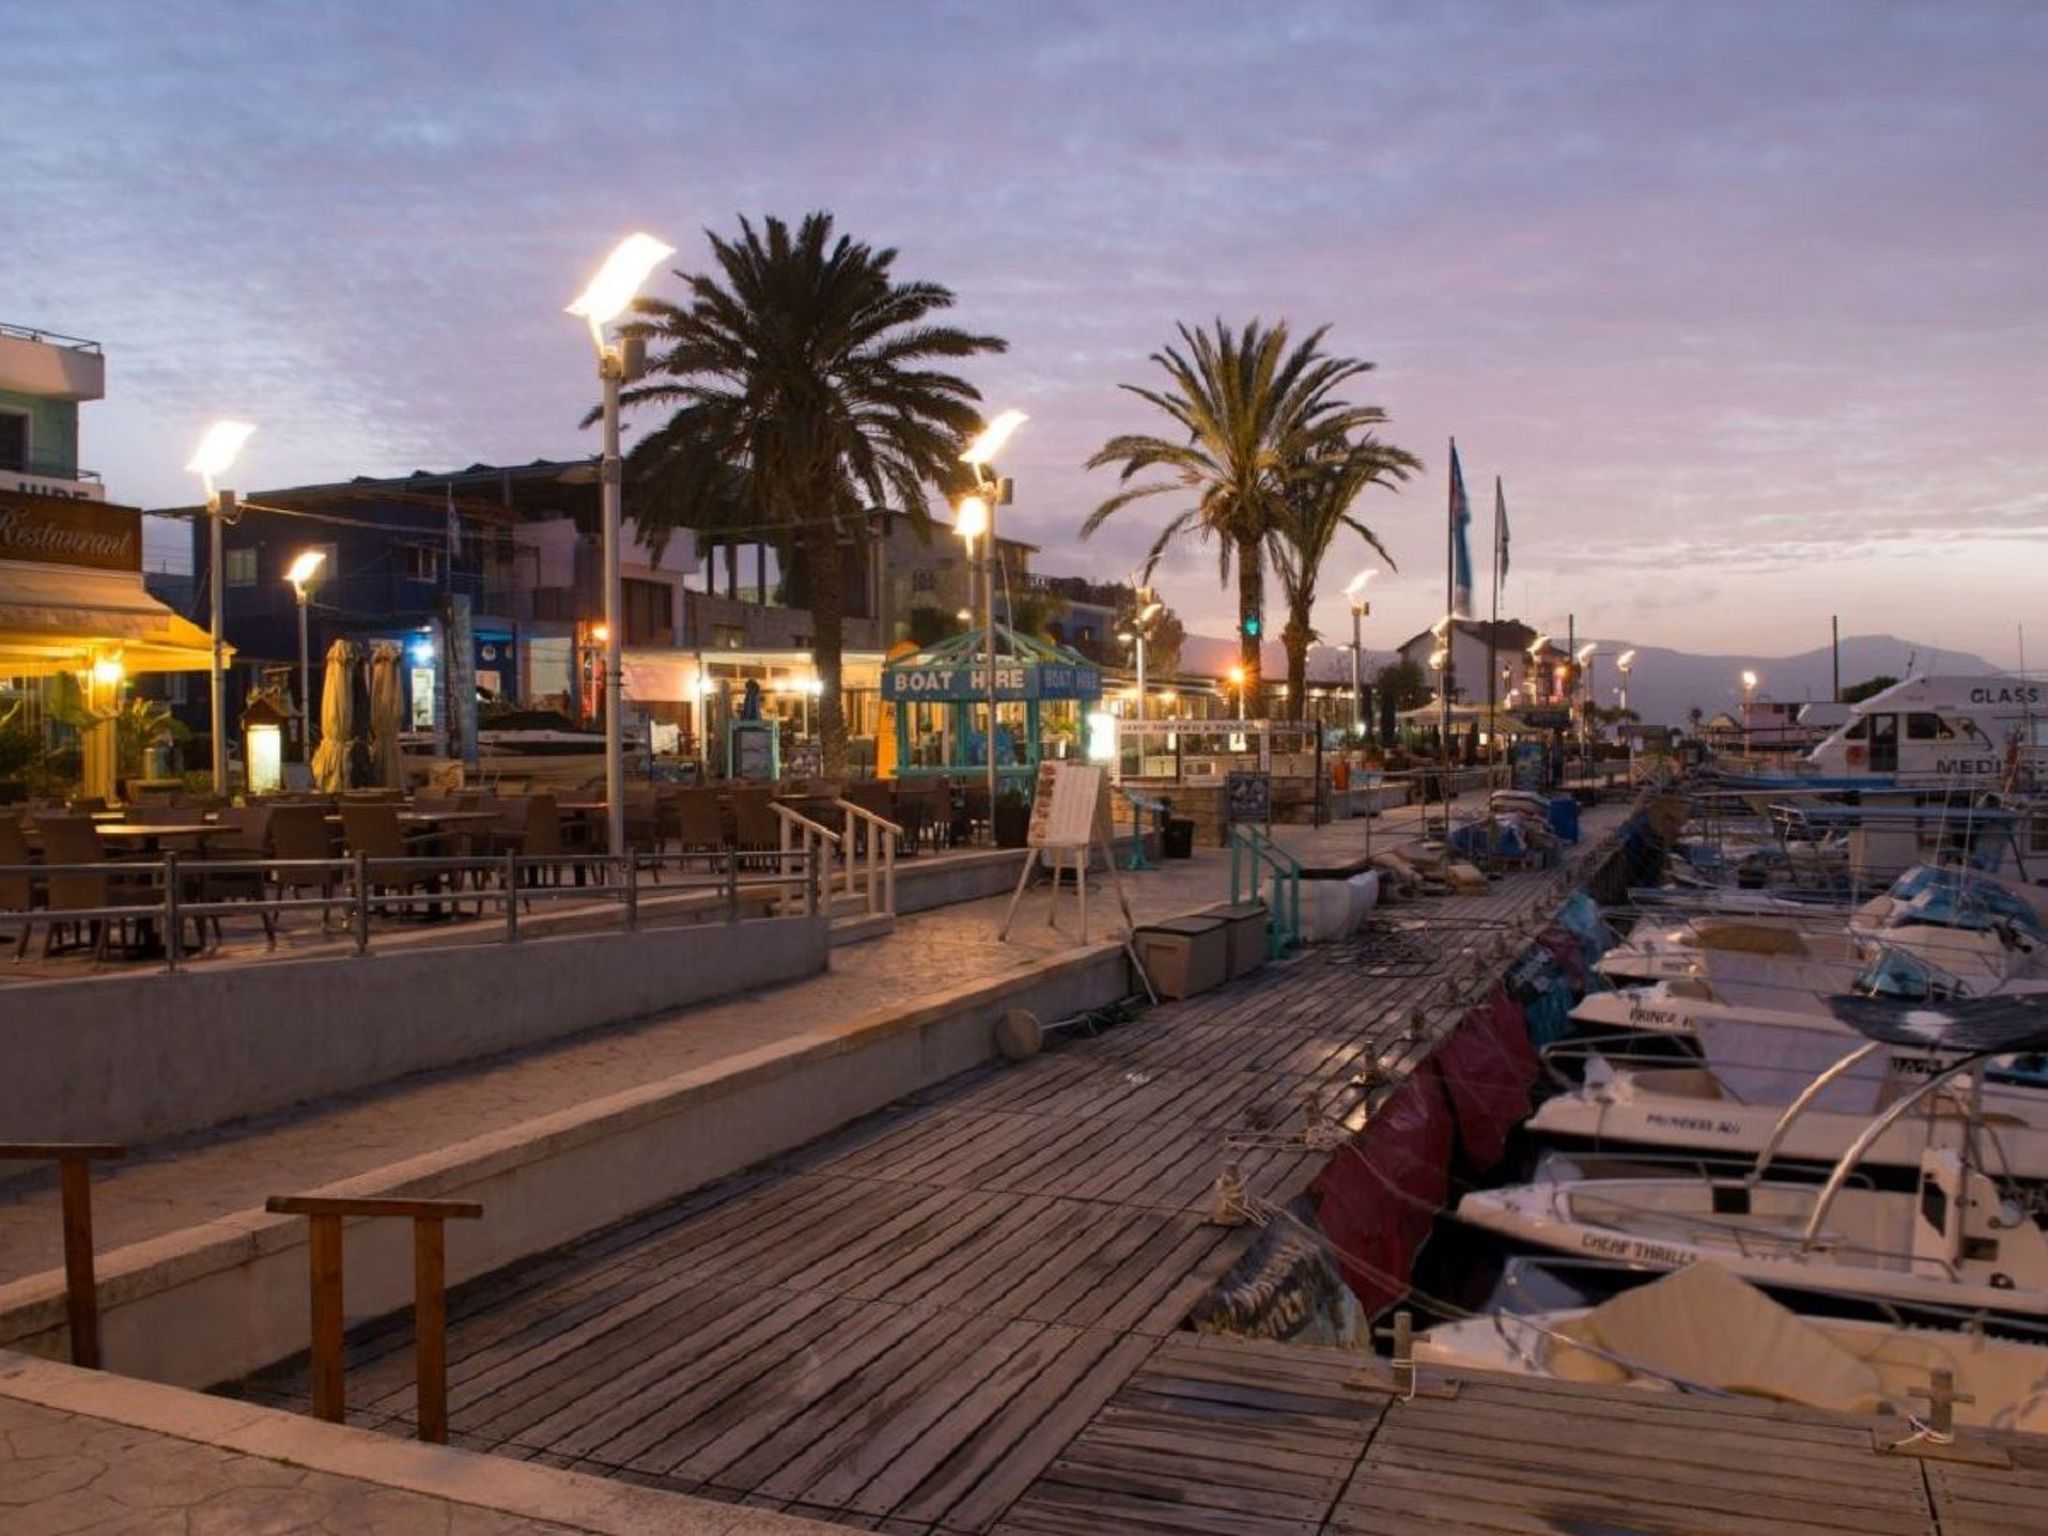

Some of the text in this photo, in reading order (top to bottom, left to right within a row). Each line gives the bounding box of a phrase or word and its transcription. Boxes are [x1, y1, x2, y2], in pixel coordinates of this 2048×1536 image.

[894, 669, 1025, 691] BOAT HIRE
[1045, 670, 1071, 687] BOAT
[1970, 687, 2039, 704] GLASS
[1581, 1232, 1630, 1256] CHEAP
